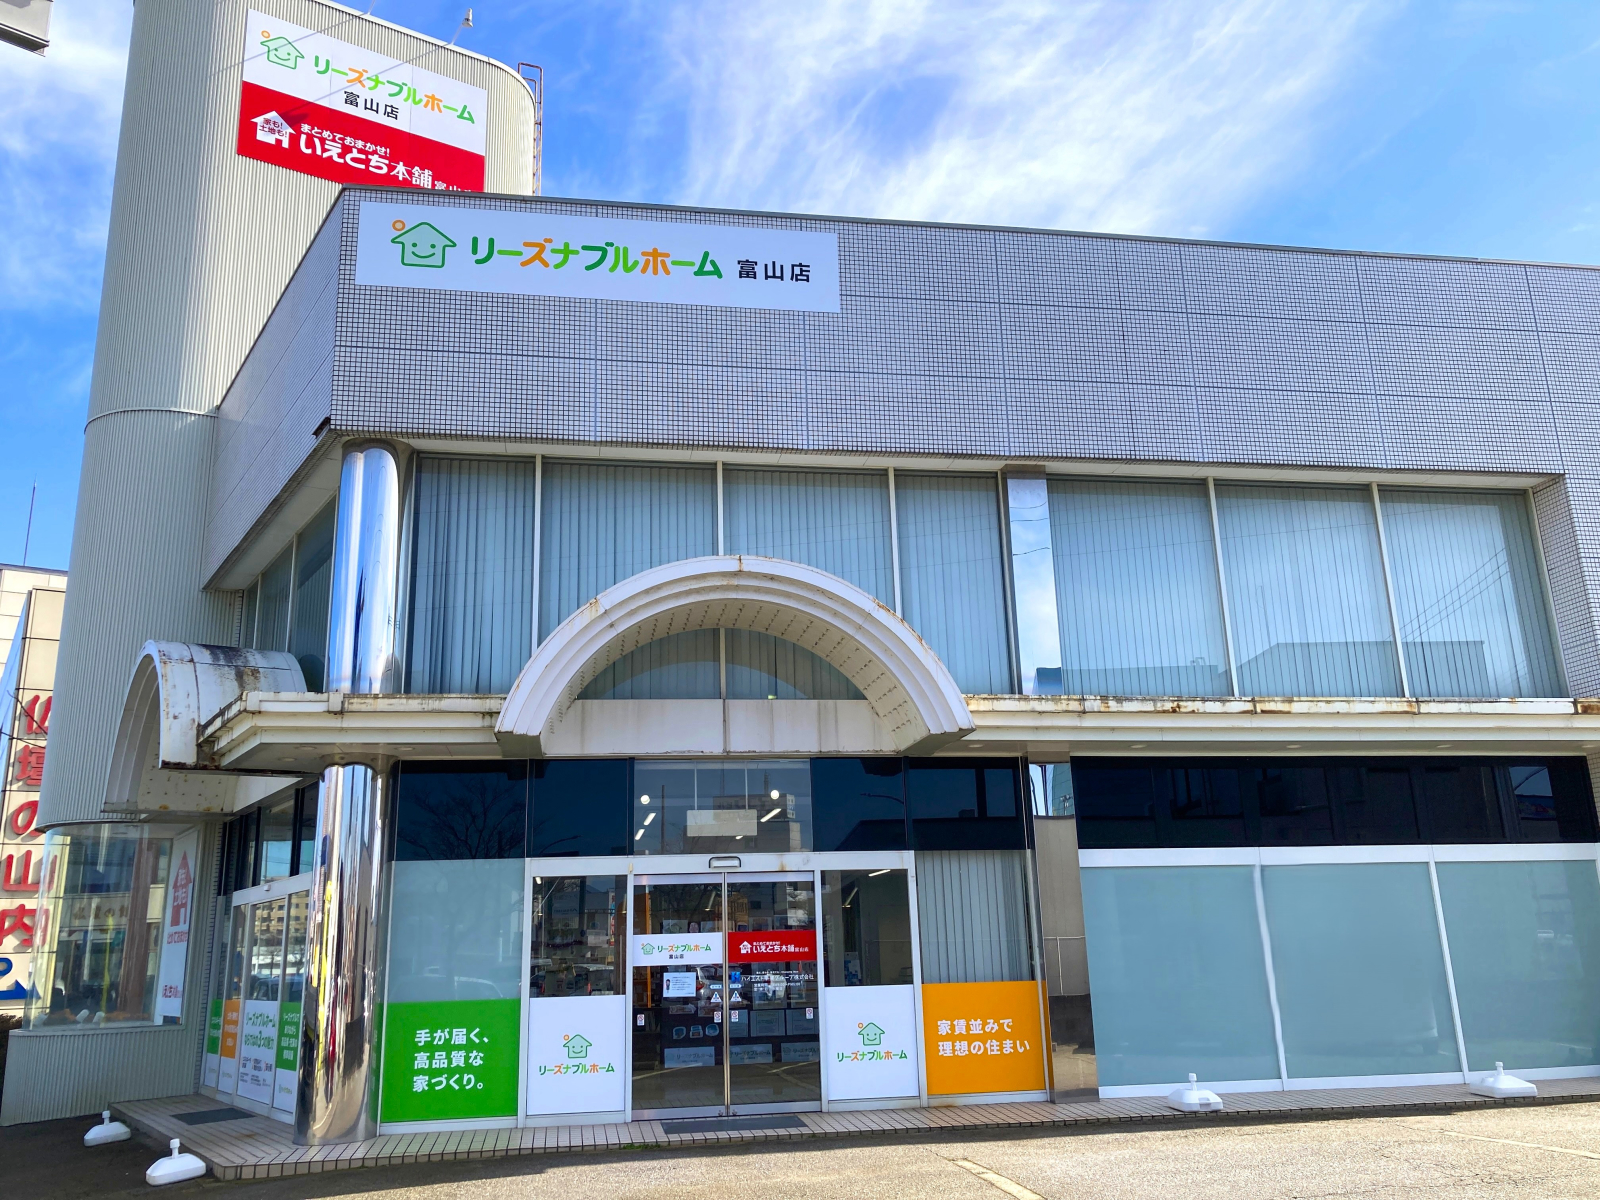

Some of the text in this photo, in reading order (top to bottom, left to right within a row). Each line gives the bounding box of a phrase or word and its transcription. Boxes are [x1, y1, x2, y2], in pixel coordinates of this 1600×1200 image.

[314, 55, 475, 125] リーズナブルホーム
[344, 91, 400, 121] 富山店
[259, 125, 288, 138] 土地も!
[300, 123, 390, 157] まとめておまかせ!
[299, 134, 433, 188] いえとち本舗
[472, 236, 811, 283] リーズナブルホーム 富山店
[657, 943, 712, 953] リーズナブルホーム
[937, 1018, 1013, 1035] 家賃並みで
[414, 1028, 490, 1047] 手が届く、
[837, 1049, 908, 1062] リーズナブルホーム
[938, 1039, 1030, 1057] 理想の住まい
[414, 1050, 484, 1069] 高品質な
[539, 1063, 615, 1076] リーズナブルホーム
[412, 1073, 484, 1092] 家づくり。
